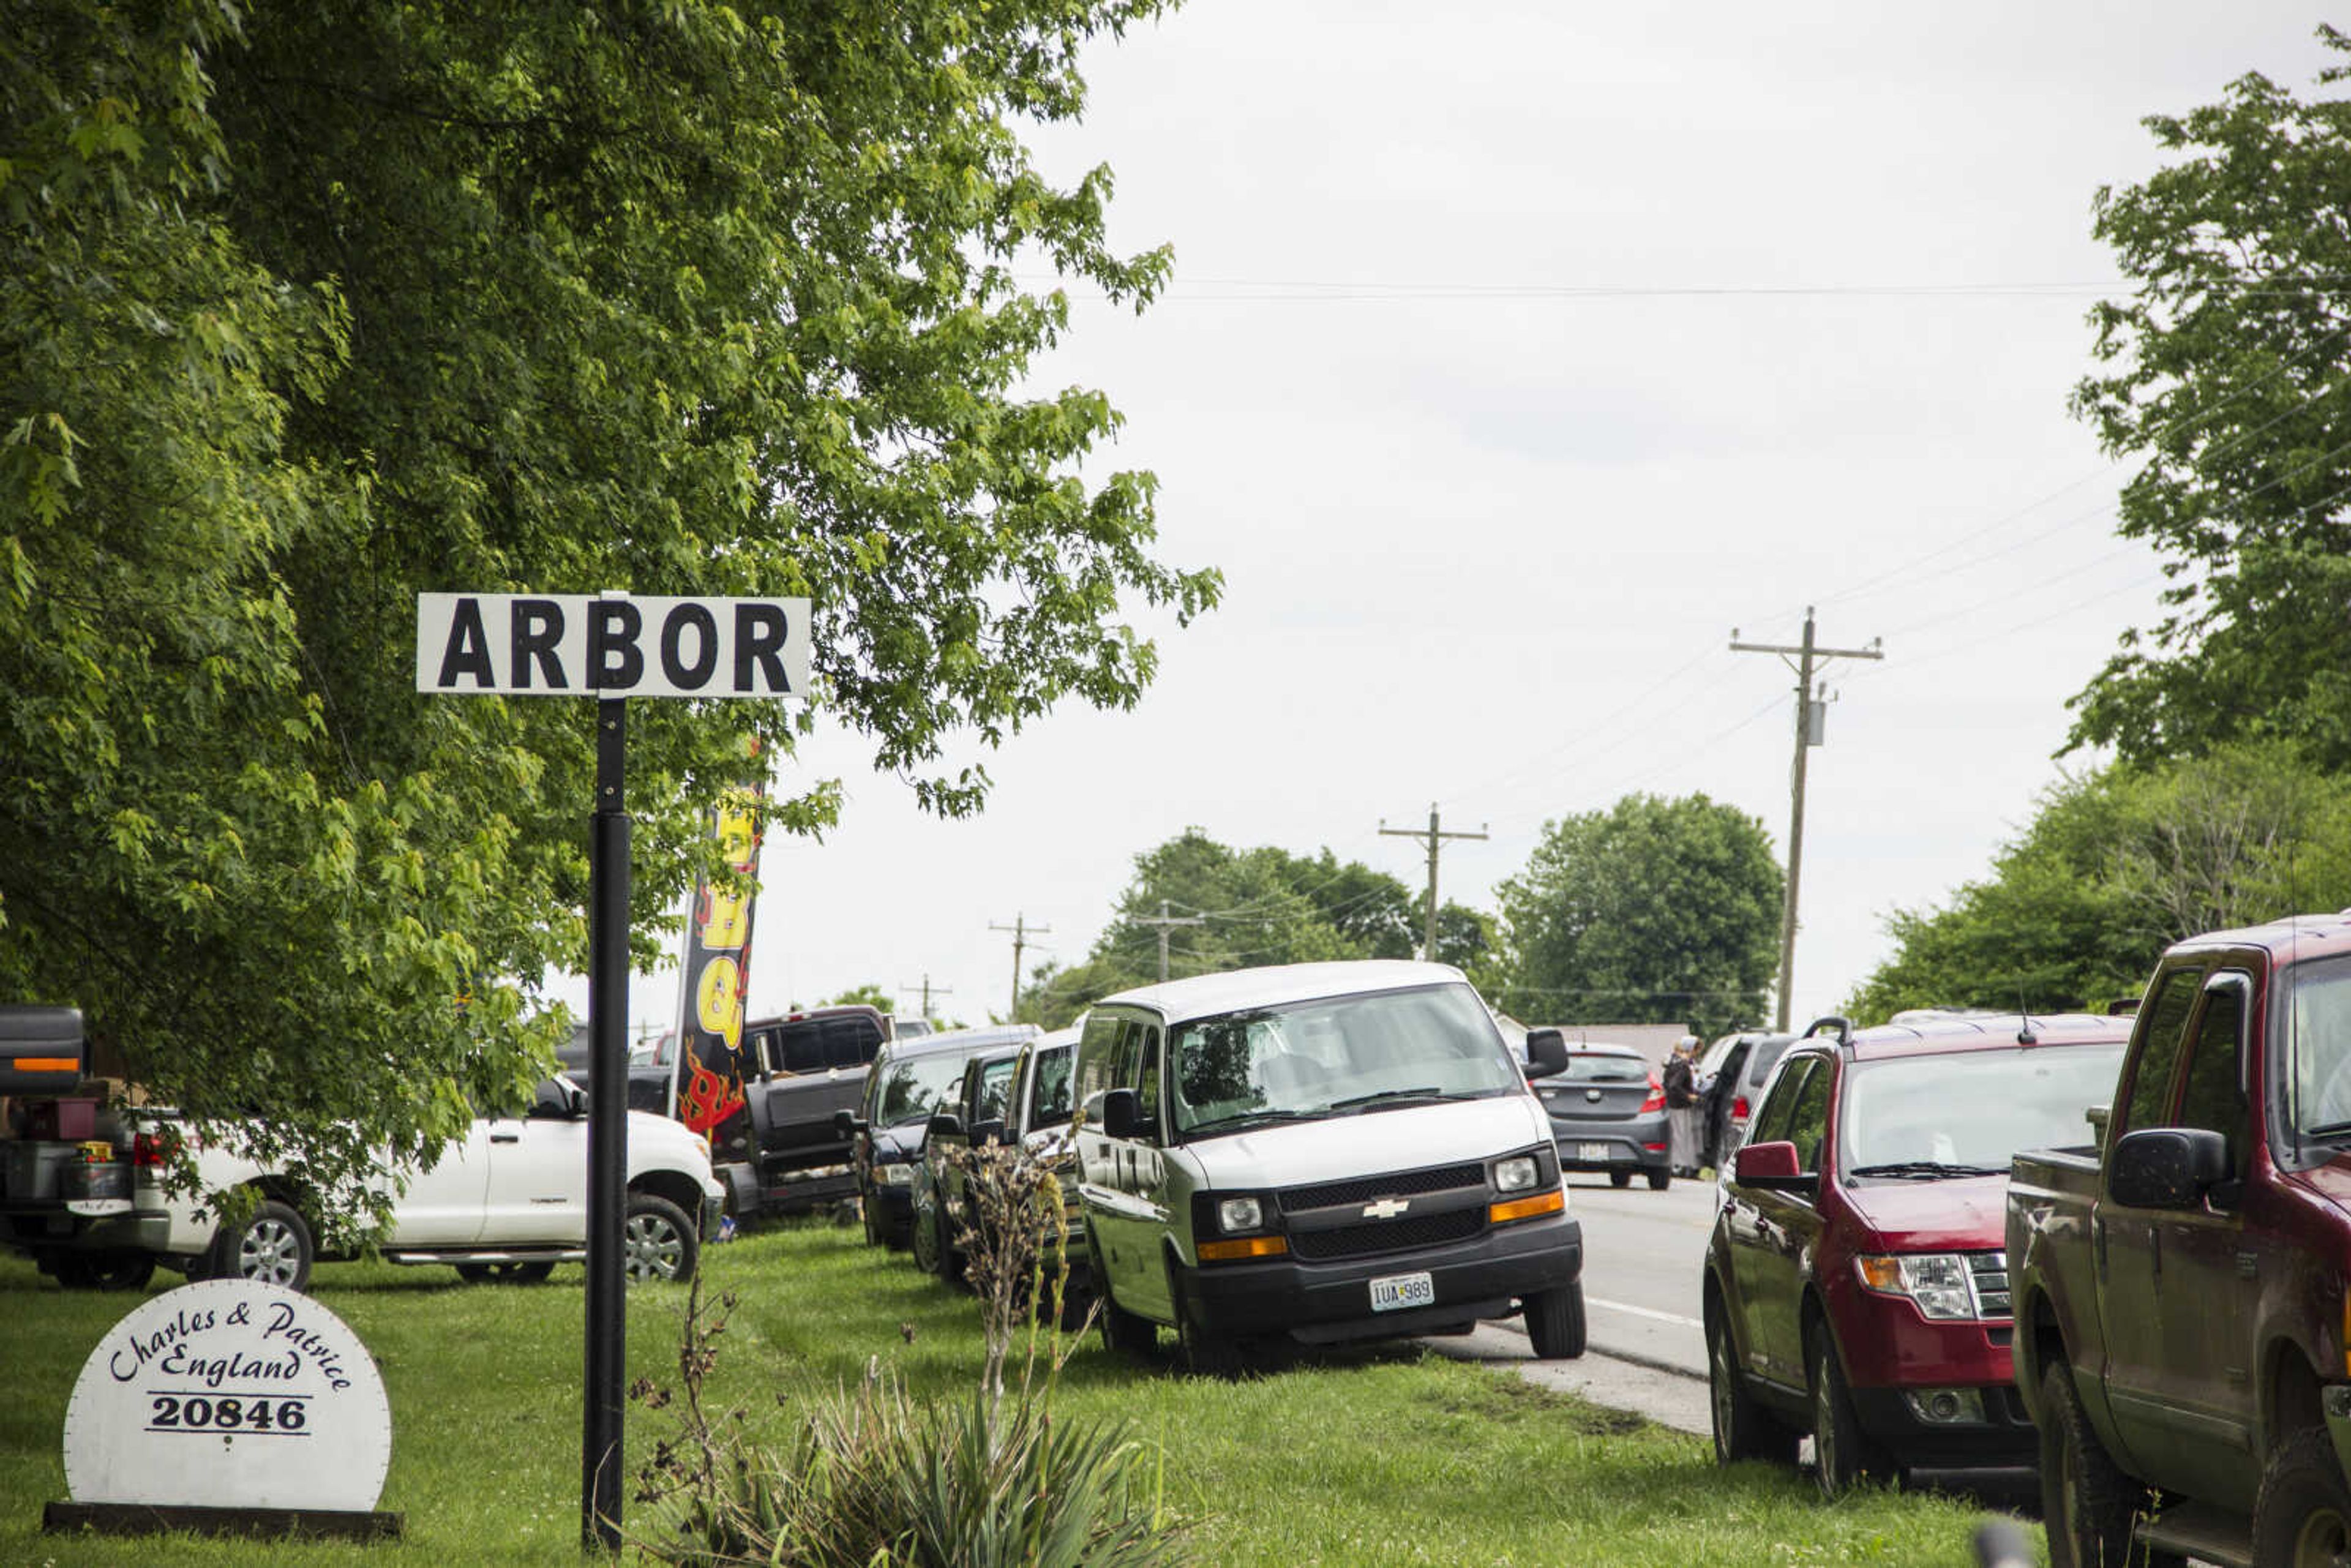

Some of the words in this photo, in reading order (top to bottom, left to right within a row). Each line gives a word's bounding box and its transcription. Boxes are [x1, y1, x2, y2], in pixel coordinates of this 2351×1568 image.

[438, 598, 792, 692] ARBOR
[110, 1310, 215, 1382] Charles
[227, 1302, 250, 1325] &
[263, 1302, 351, 1392] Patrice
[161, 1344, 301, 1387] England
[152, 1397, 306, 1430] 20846
